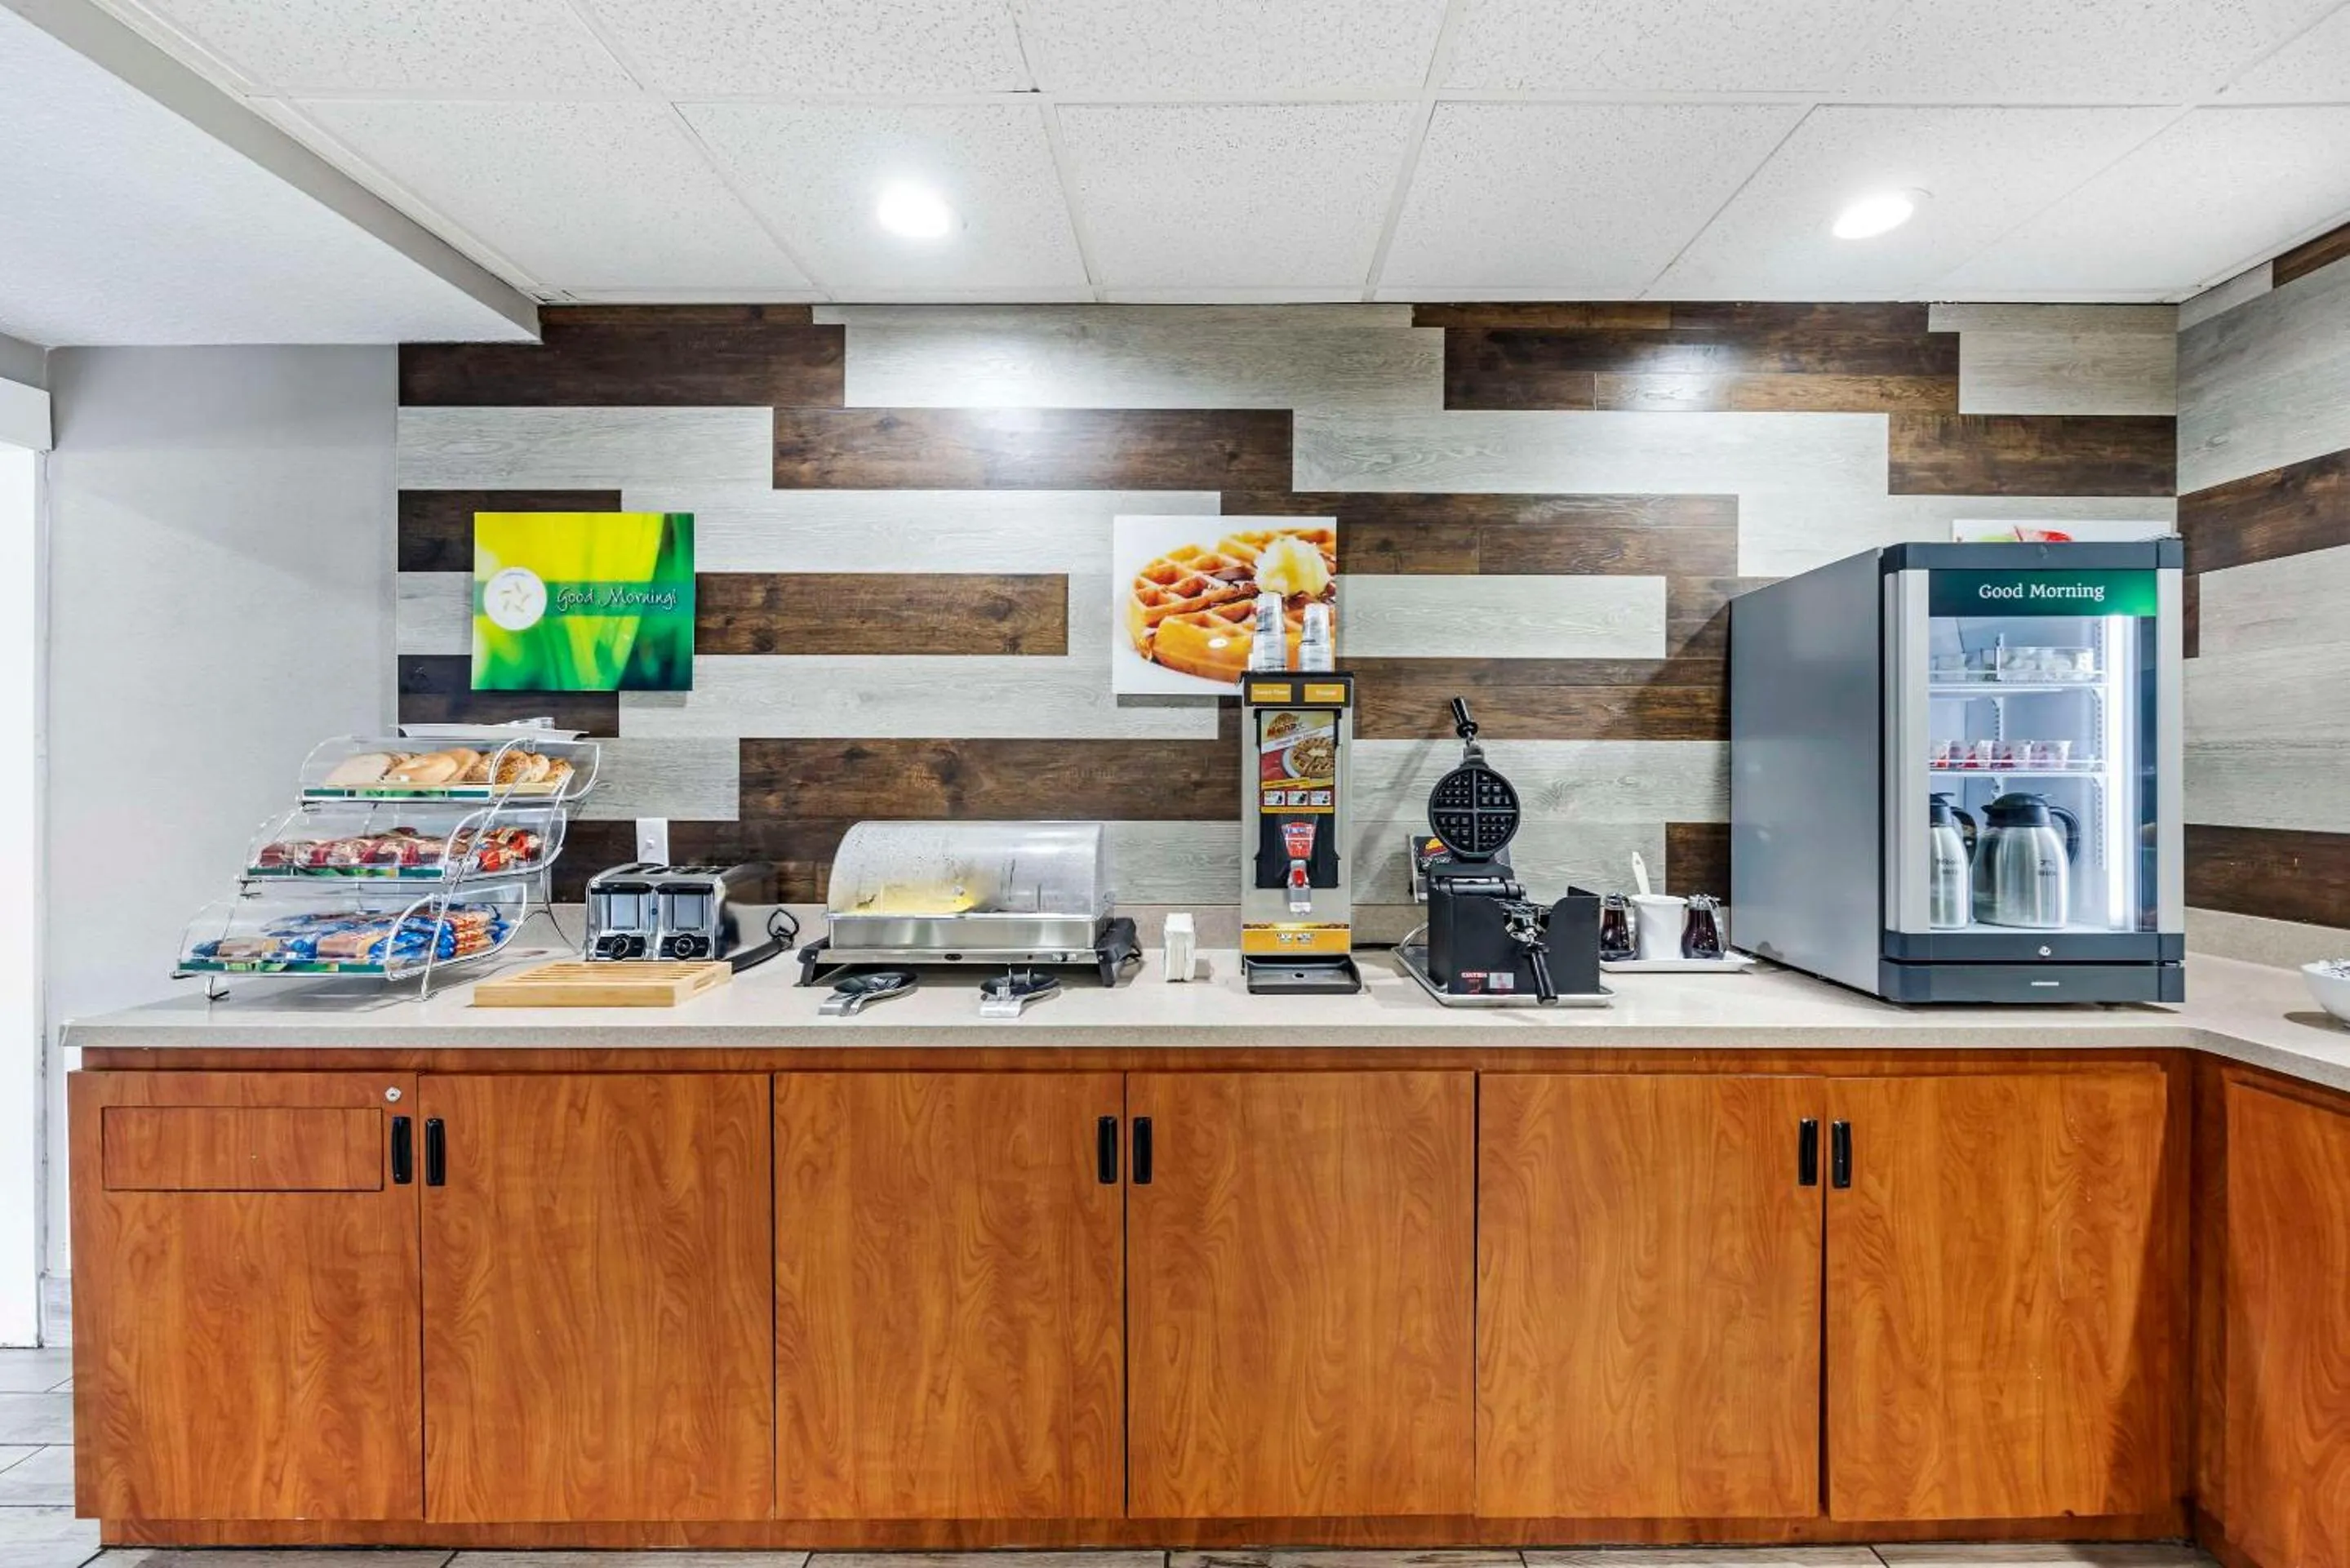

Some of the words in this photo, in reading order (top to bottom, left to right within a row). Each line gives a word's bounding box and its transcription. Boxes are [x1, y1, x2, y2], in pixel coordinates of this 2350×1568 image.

[557, 587, 594, 611] Good
[597, 585, 677, 611] Morning!
[1979, 582, 2023, 599] Good
[2029, 582, 2105, 602] Morning
